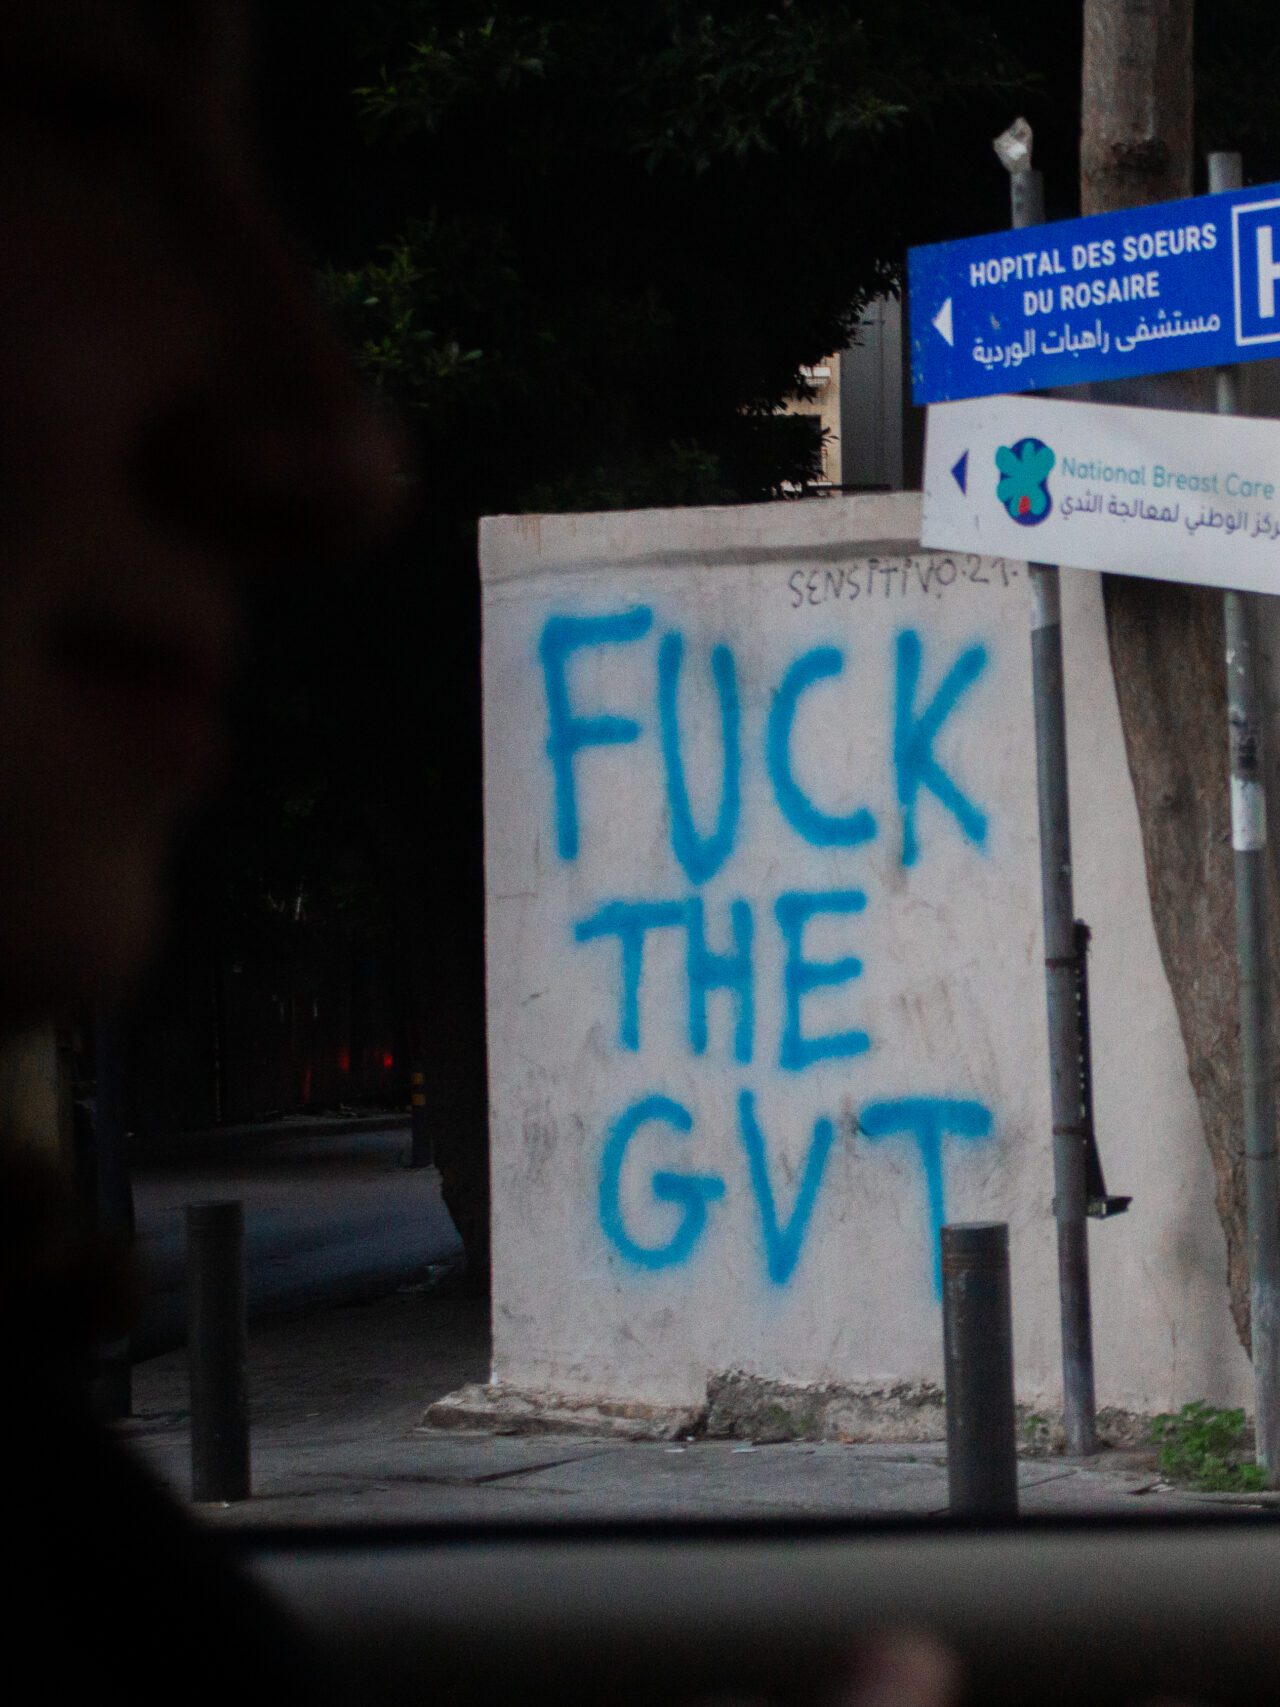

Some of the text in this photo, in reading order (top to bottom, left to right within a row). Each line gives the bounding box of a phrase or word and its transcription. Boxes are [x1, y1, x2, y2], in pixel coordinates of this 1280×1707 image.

[970, 223, 1217, 288] HOPITAL DES SOEURS
[1024, 271, 1160, 316] DU ROSAIRE
[972, 309, 1221, 370] مستشفى راهبات الوردية
[1060, 489, 1103, 518] الثدي
[1061, 456, 1146, 487] National
[1152, 464, 1219, 494] Breast
[1224, 472, 1275, 500] Care
[1108, 493, 1180, 524] لمعالجة
[1185, 502, 1248, 537] الوطني
[538, 602, 990, 885] FUCK
[573, 888, 872, 1073] THE
[596, 1087, 994, 1305] GVT
